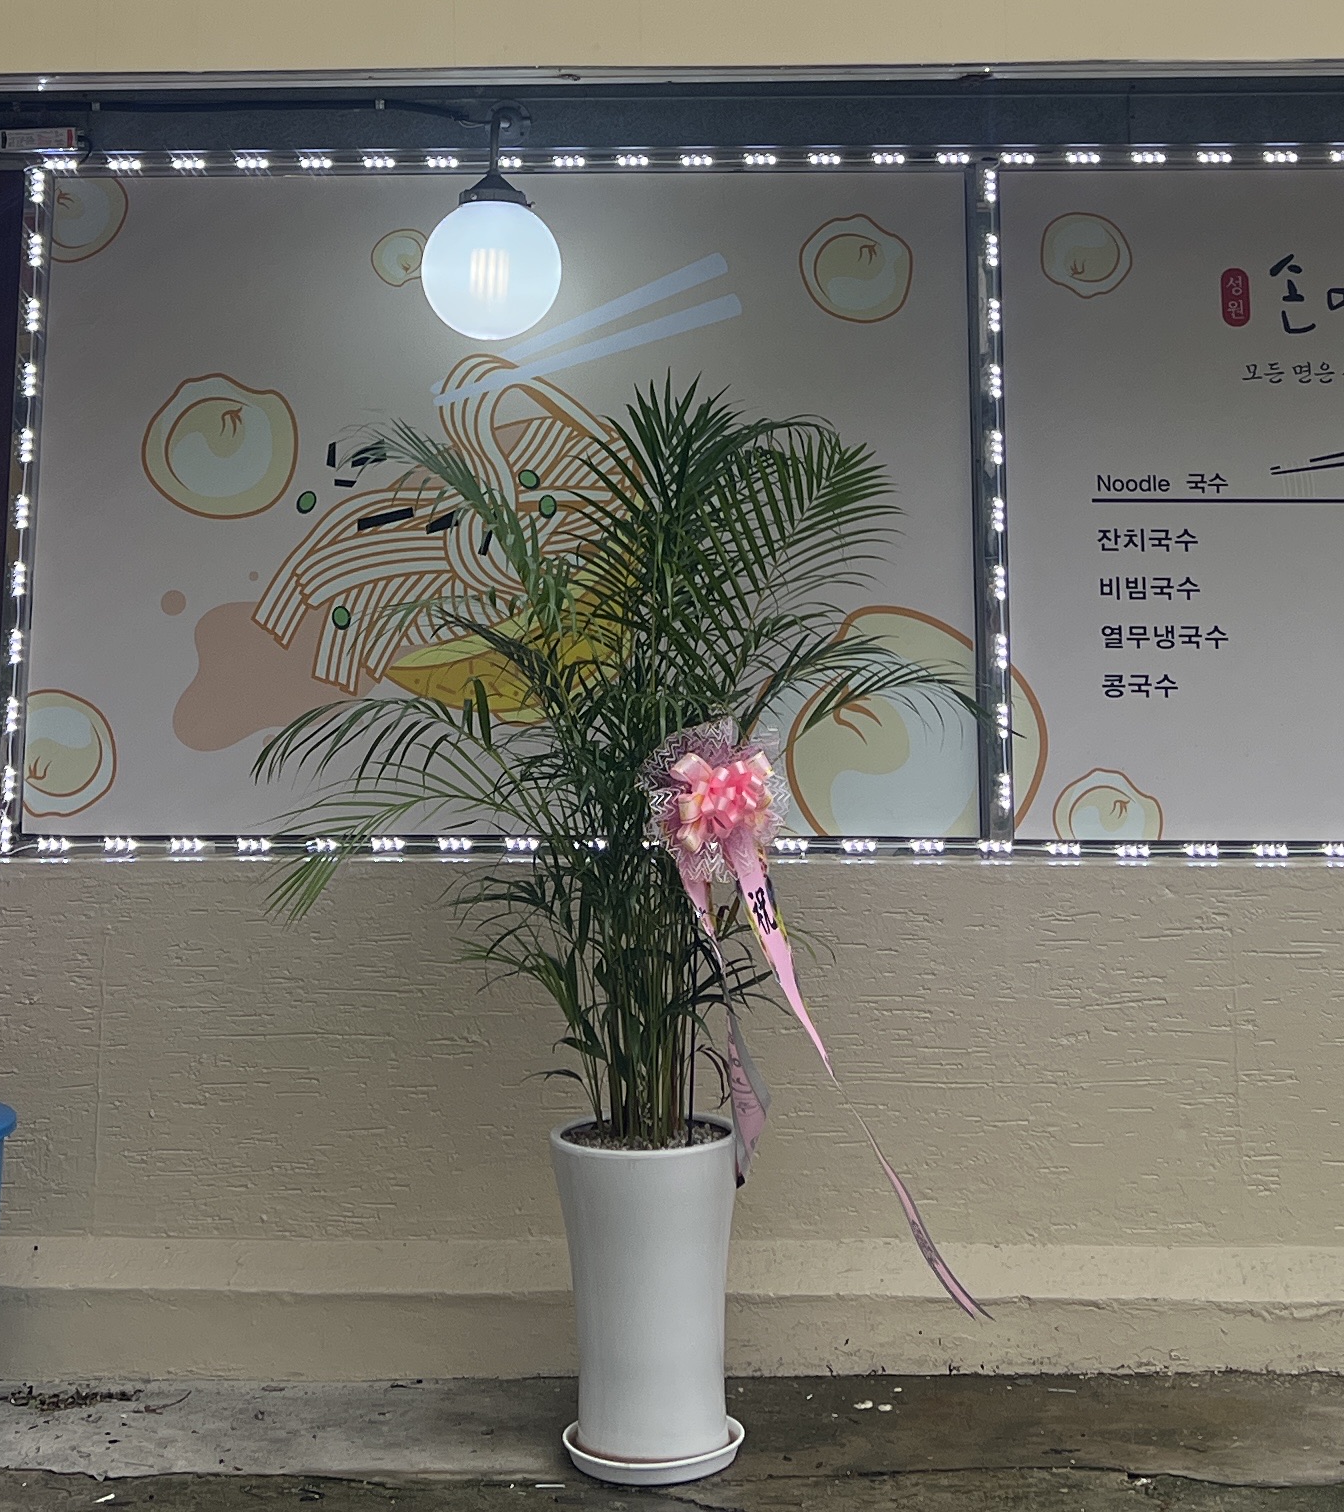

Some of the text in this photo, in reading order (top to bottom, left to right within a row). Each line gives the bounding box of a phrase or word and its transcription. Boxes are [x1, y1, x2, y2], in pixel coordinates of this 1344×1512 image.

[1225, 275, 1246, 320] 성원
[1242, 361, 1286, 384] 모든
[1291, 361, 1336, 384] 면은
[1097, 472, 1229, 494] Noodle 국수
[1097, 528, 1199, 553] 잔치국수
[1099, 576, 1201, 601] 비빔국수
[1101, 624, 1229, 650] 열무냉국수
[1102, 673, 1179, 699] 콩국수
[747, 886, 778, 935] 祝
